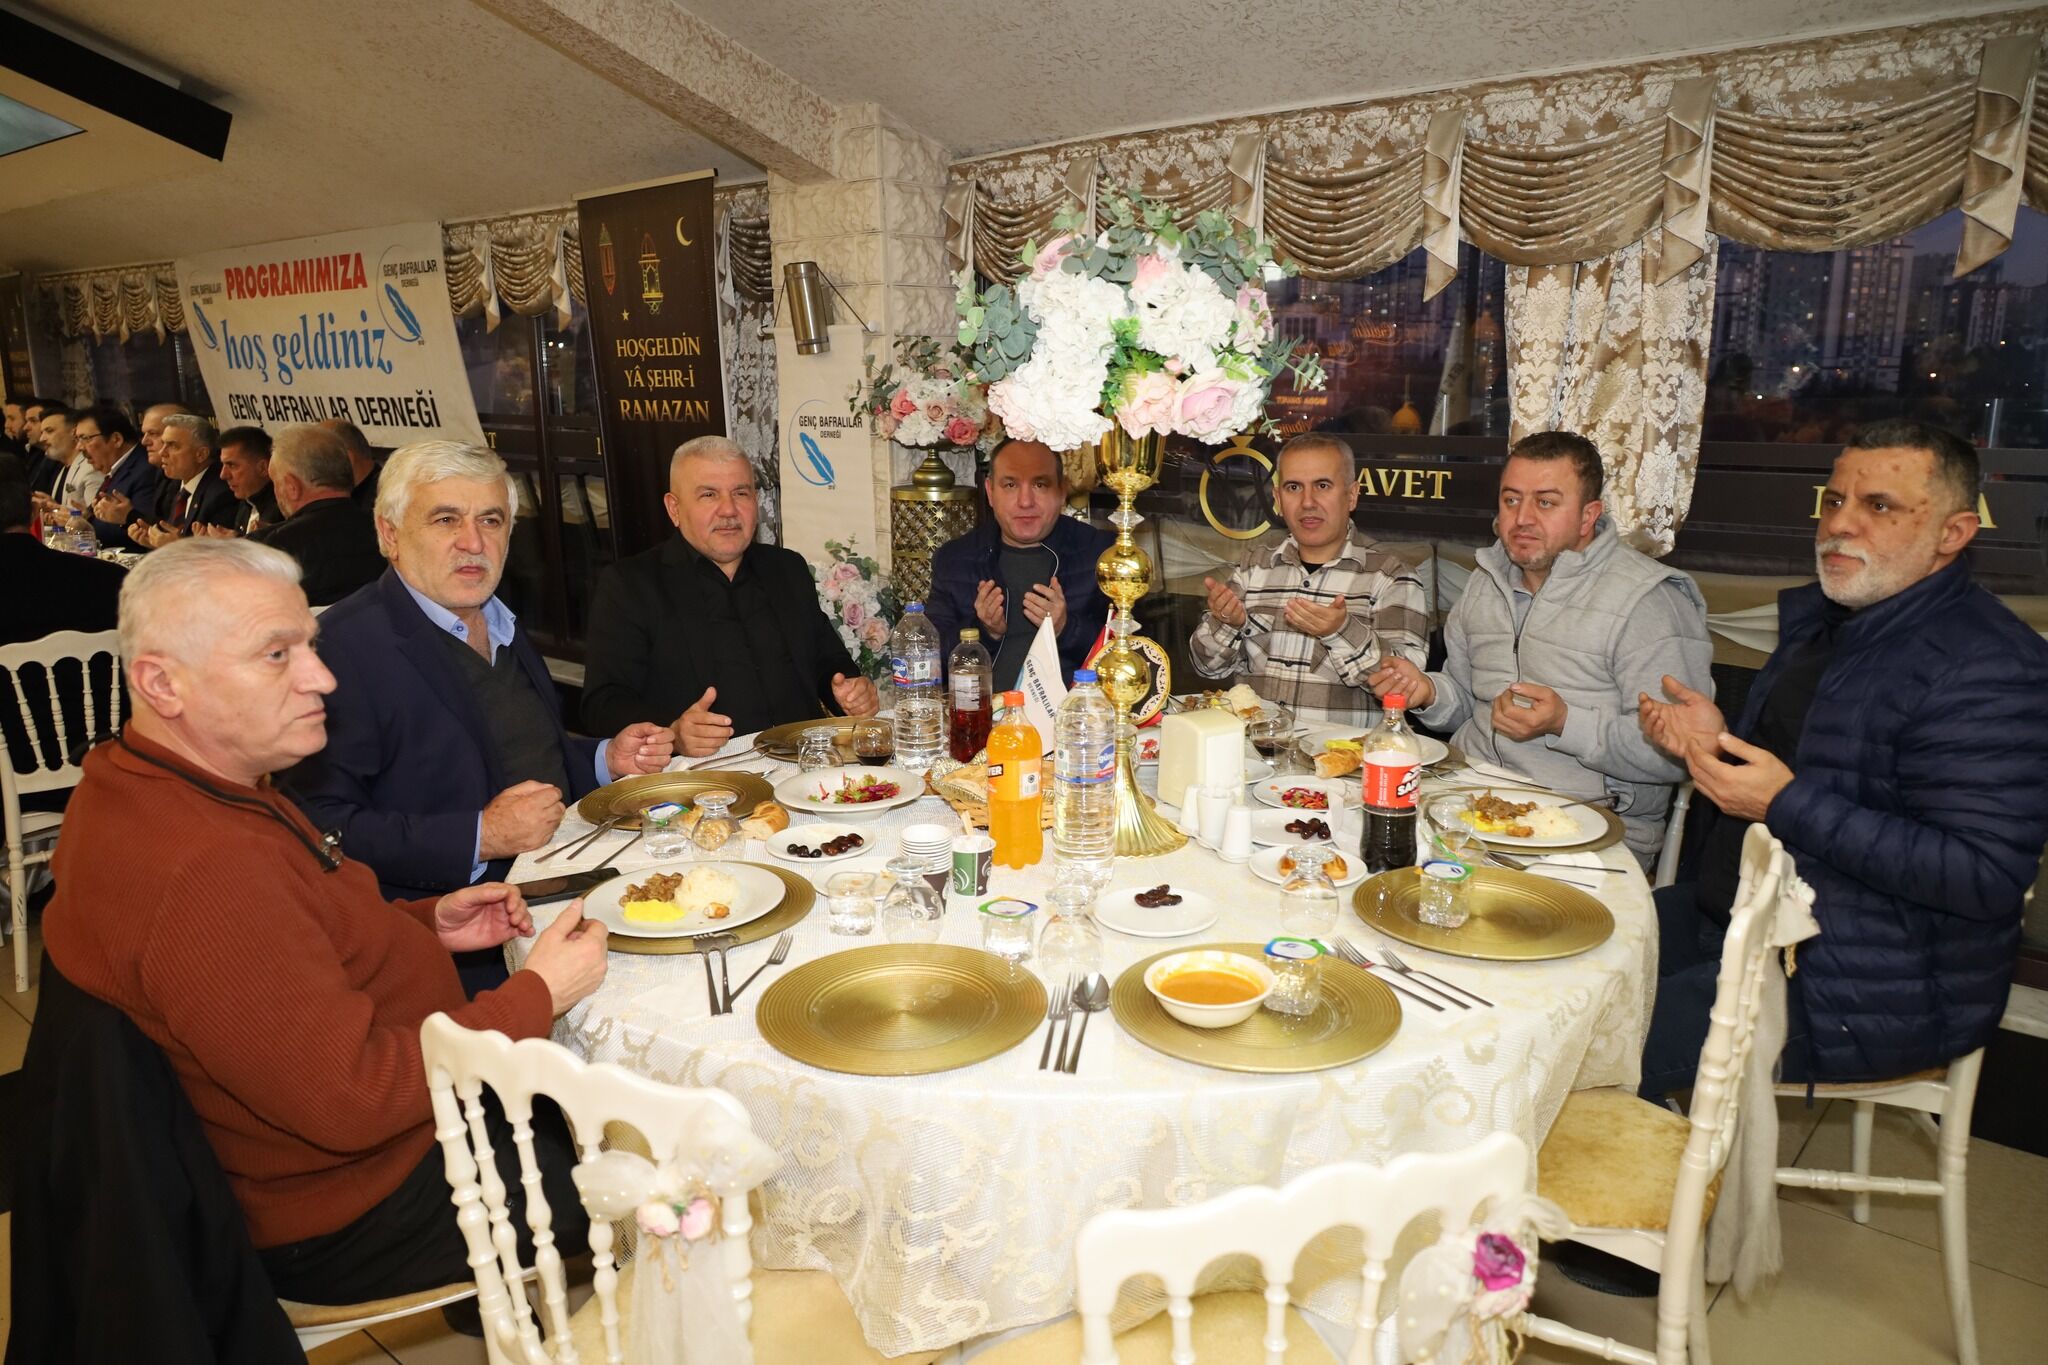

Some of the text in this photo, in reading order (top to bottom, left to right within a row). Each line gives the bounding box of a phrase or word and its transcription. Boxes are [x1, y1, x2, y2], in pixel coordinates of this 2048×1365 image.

[224, 253, 368, 300] PROGRAMIMIZA
[220, 309, 393, 385] hoş geldiniz
[616, 332, 700, 361] HOŞGELDİN
[624, 364, 694, 392] YÂ ŞEHR-İ
[229, 393, 263, 428] GENÇ
[355, 388, 442, 428] DERNEĞİ
[619, 399, 711, 423] RAMAZAN
[798, 415, 817, 430] GENÇ
